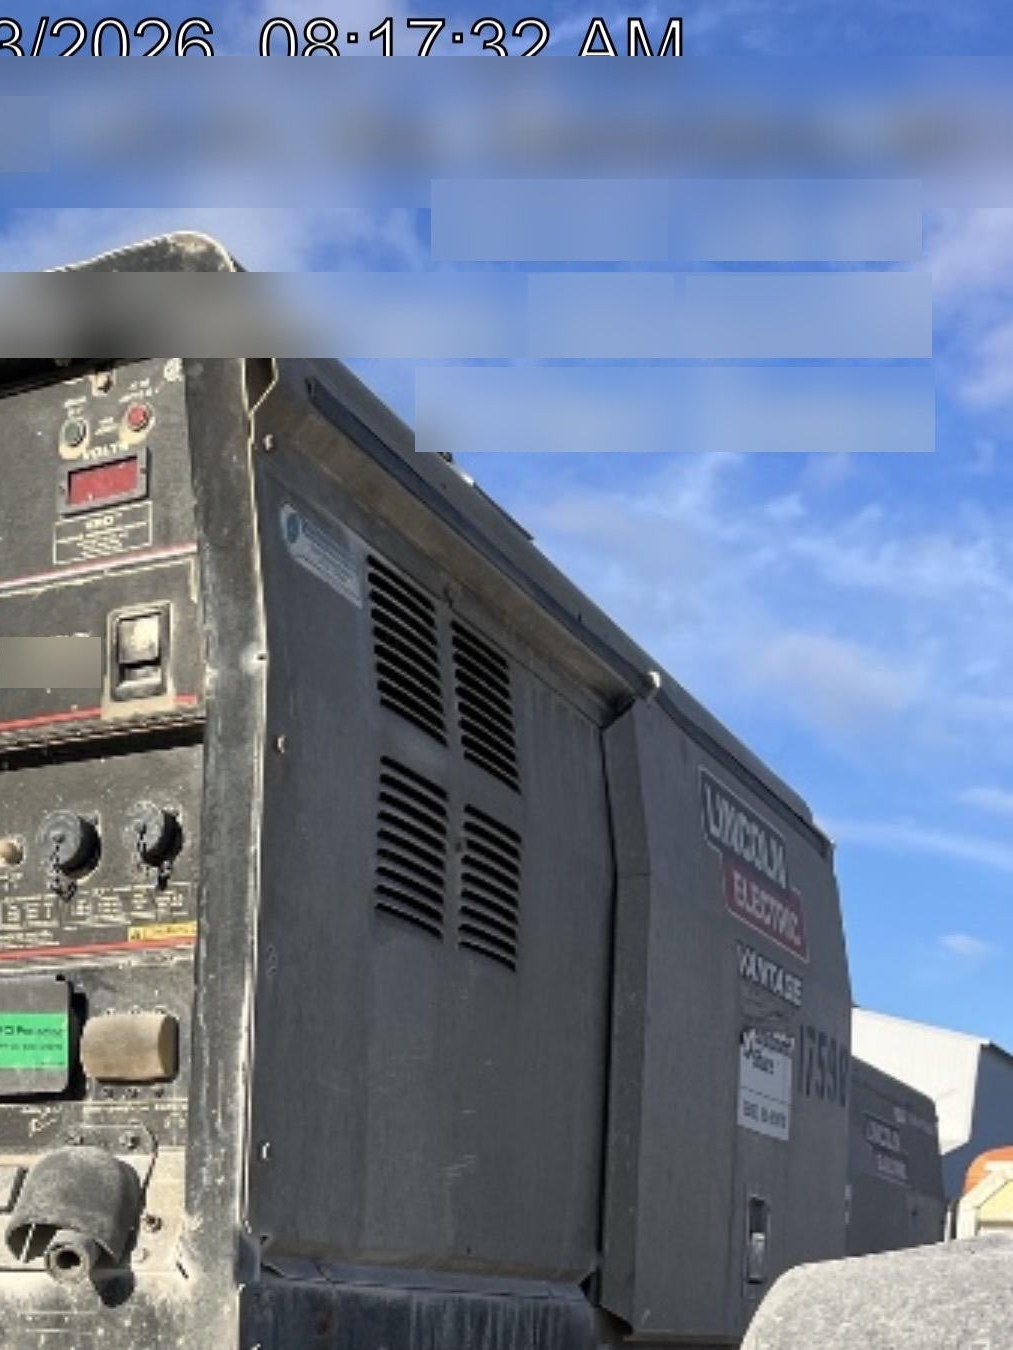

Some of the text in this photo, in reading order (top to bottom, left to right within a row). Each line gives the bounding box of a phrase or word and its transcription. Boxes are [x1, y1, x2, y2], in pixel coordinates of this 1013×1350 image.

[703, 782, 787, 890] LINCOLN
[732, 868, 802, 946] ELECTRIC
[736, 943, 802, 1007] VANTAGE
